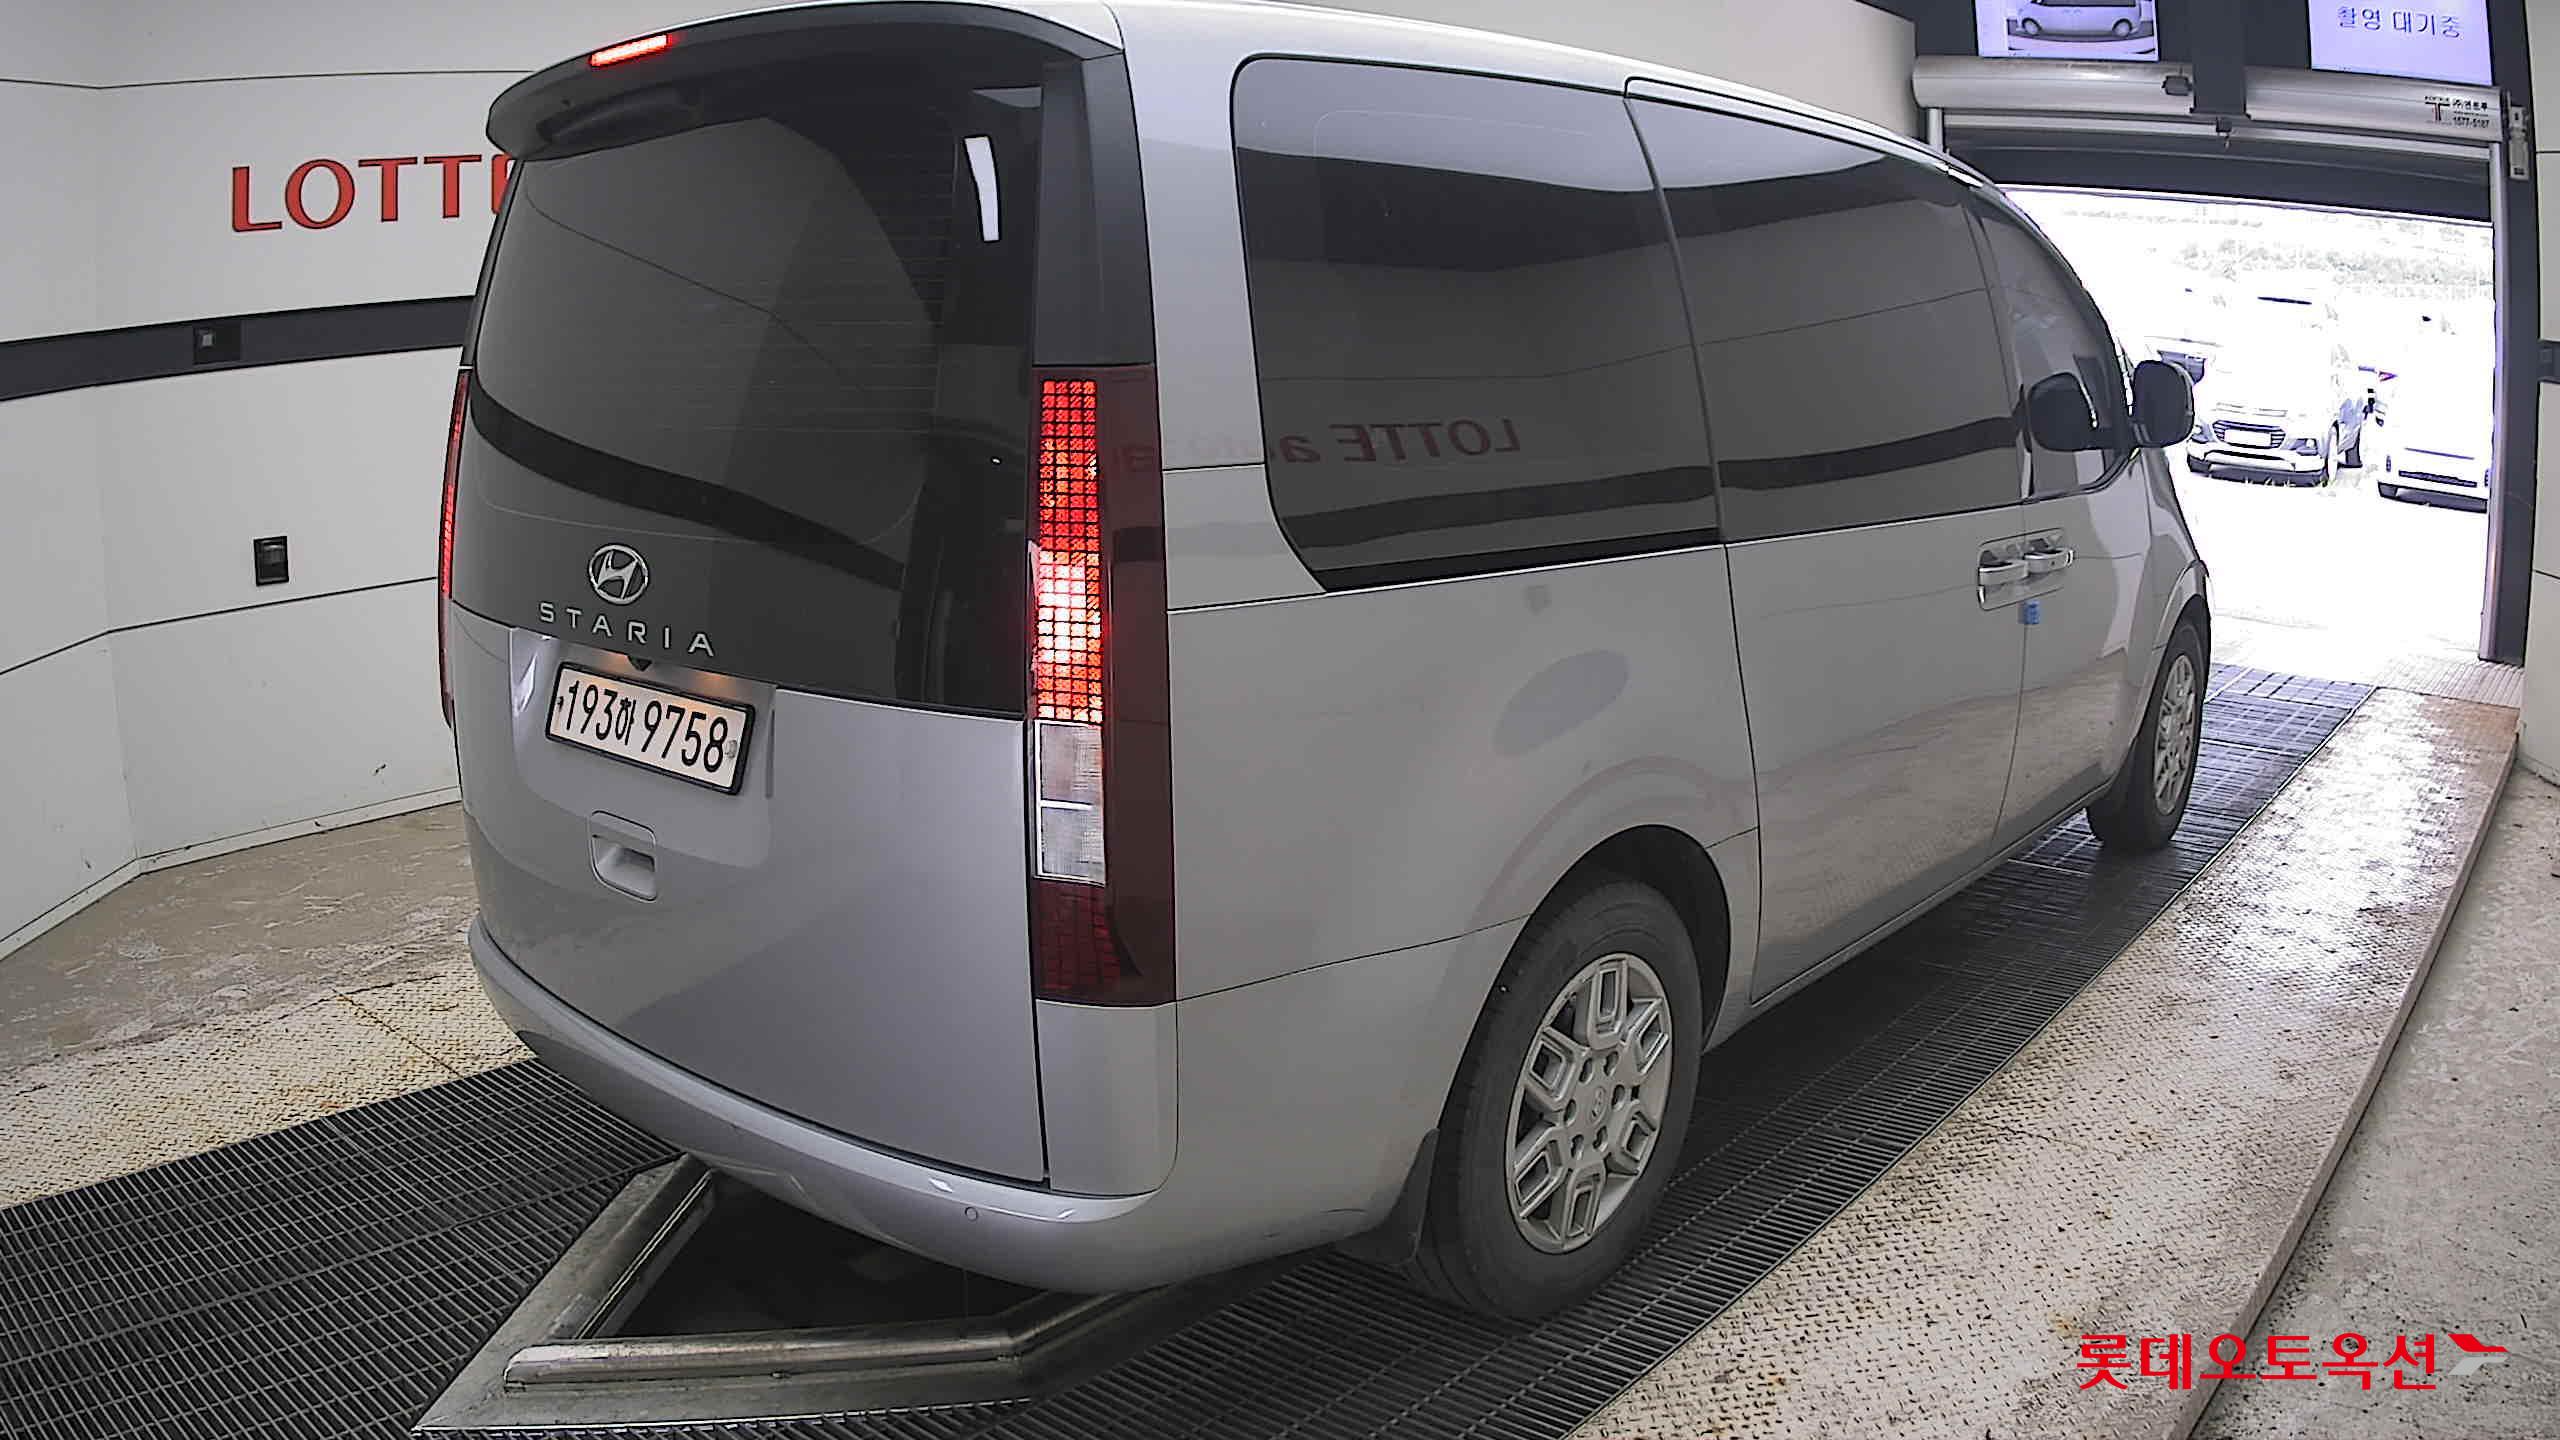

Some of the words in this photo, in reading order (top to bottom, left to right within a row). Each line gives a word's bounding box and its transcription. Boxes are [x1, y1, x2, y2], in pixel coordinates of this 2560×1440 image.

[2392, 11, 2461, 38] 대기중
[540, 602, 715, 657] STARIA
[641, 700, 729, 773] 9758
